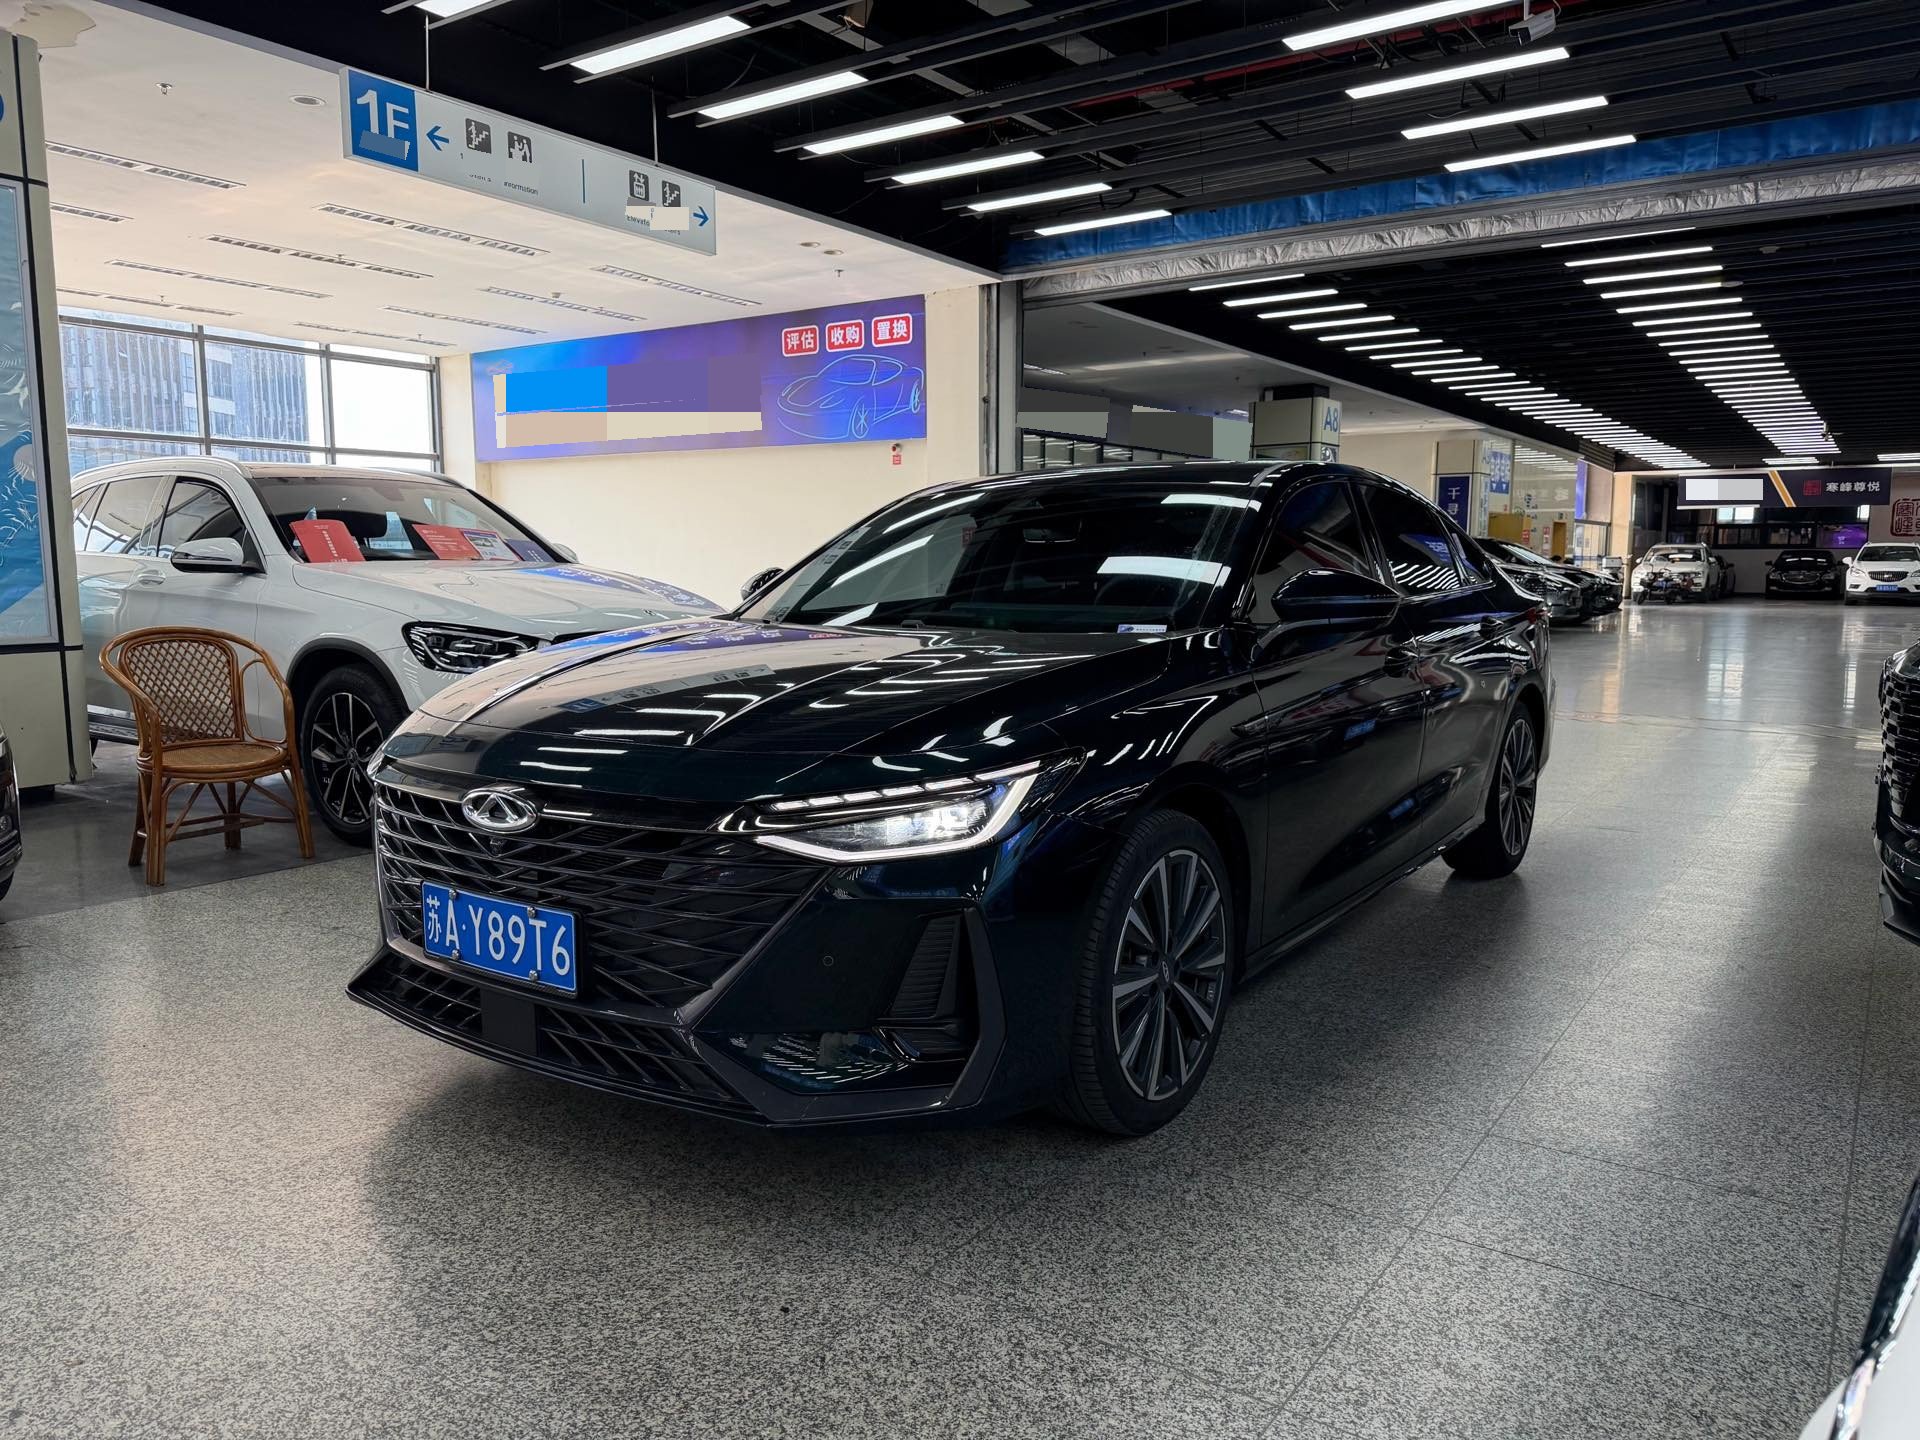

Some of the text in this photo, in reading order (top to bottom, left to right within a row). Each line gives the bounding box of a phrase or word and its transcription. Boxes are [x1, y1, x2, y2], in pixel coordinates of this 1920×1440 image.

[356, 89, 410, 139] 1F
[786, 330, 815, 351] 评估
[830, 325, 861, 346] 收购
[876, 319, 909, 341] 置换
[1323, 406, 1339, 433] A8
